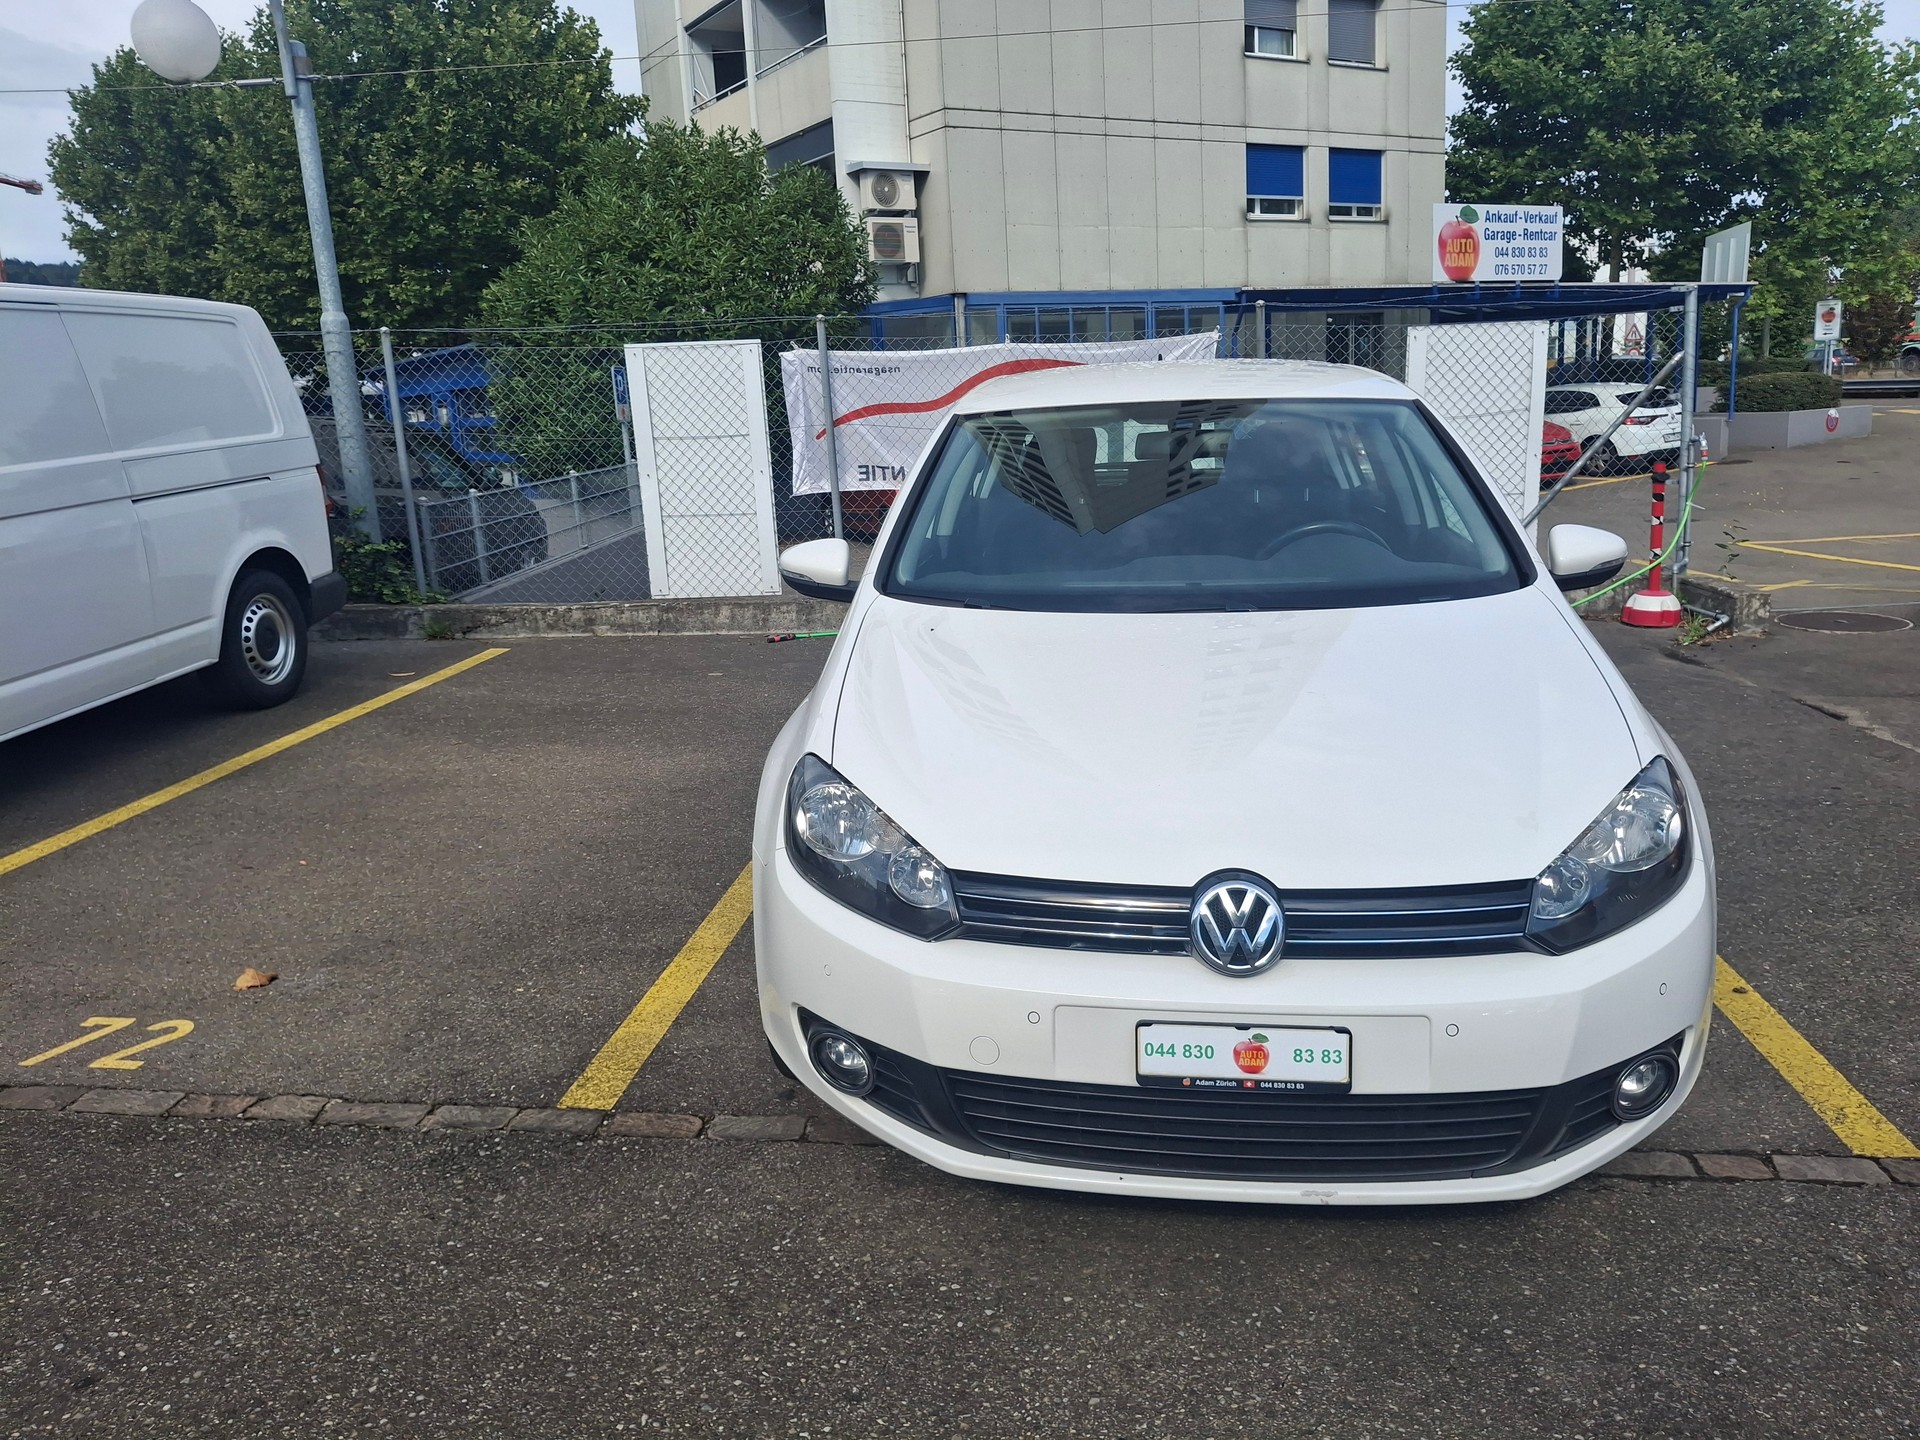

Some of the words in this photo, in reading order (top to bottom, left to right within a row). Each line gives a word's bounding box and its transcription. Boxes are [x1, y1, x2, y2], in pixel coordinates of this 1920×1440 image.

[1485, 210, 1558, 224] Ankauf-Verkauf
[1446, 239, 1474, 252] AUTO
[1494, 247, 1509, 258] 044
[1511, 247, 1525, 258] 830
[1527, 247, 1537, 258] 83
[1538, 247, 1548, 258] 83
[1445, 253, 1474, 267] ADAM
[1494, 264, 1508, 275] 076
[1511, 264, 1525, 275] 570
[1527, 264, 1537, 275] 57
[1538, 264, 1548, 275] 27
[18, 1017, 195, 1070] 72
[1144, 1042, 1176, 1057] 044
[1182, 1044, 1214, 1059] 830
[1293, 1048, 1314, 1063] 83
[1321, 1049, 1342, 1064] 83
[1240, 1050, 1264, 1059] AUTO
[1238, 1058, 1265, 1067] ADAM
[1215, 1079, 1237, 1087] Zürich
